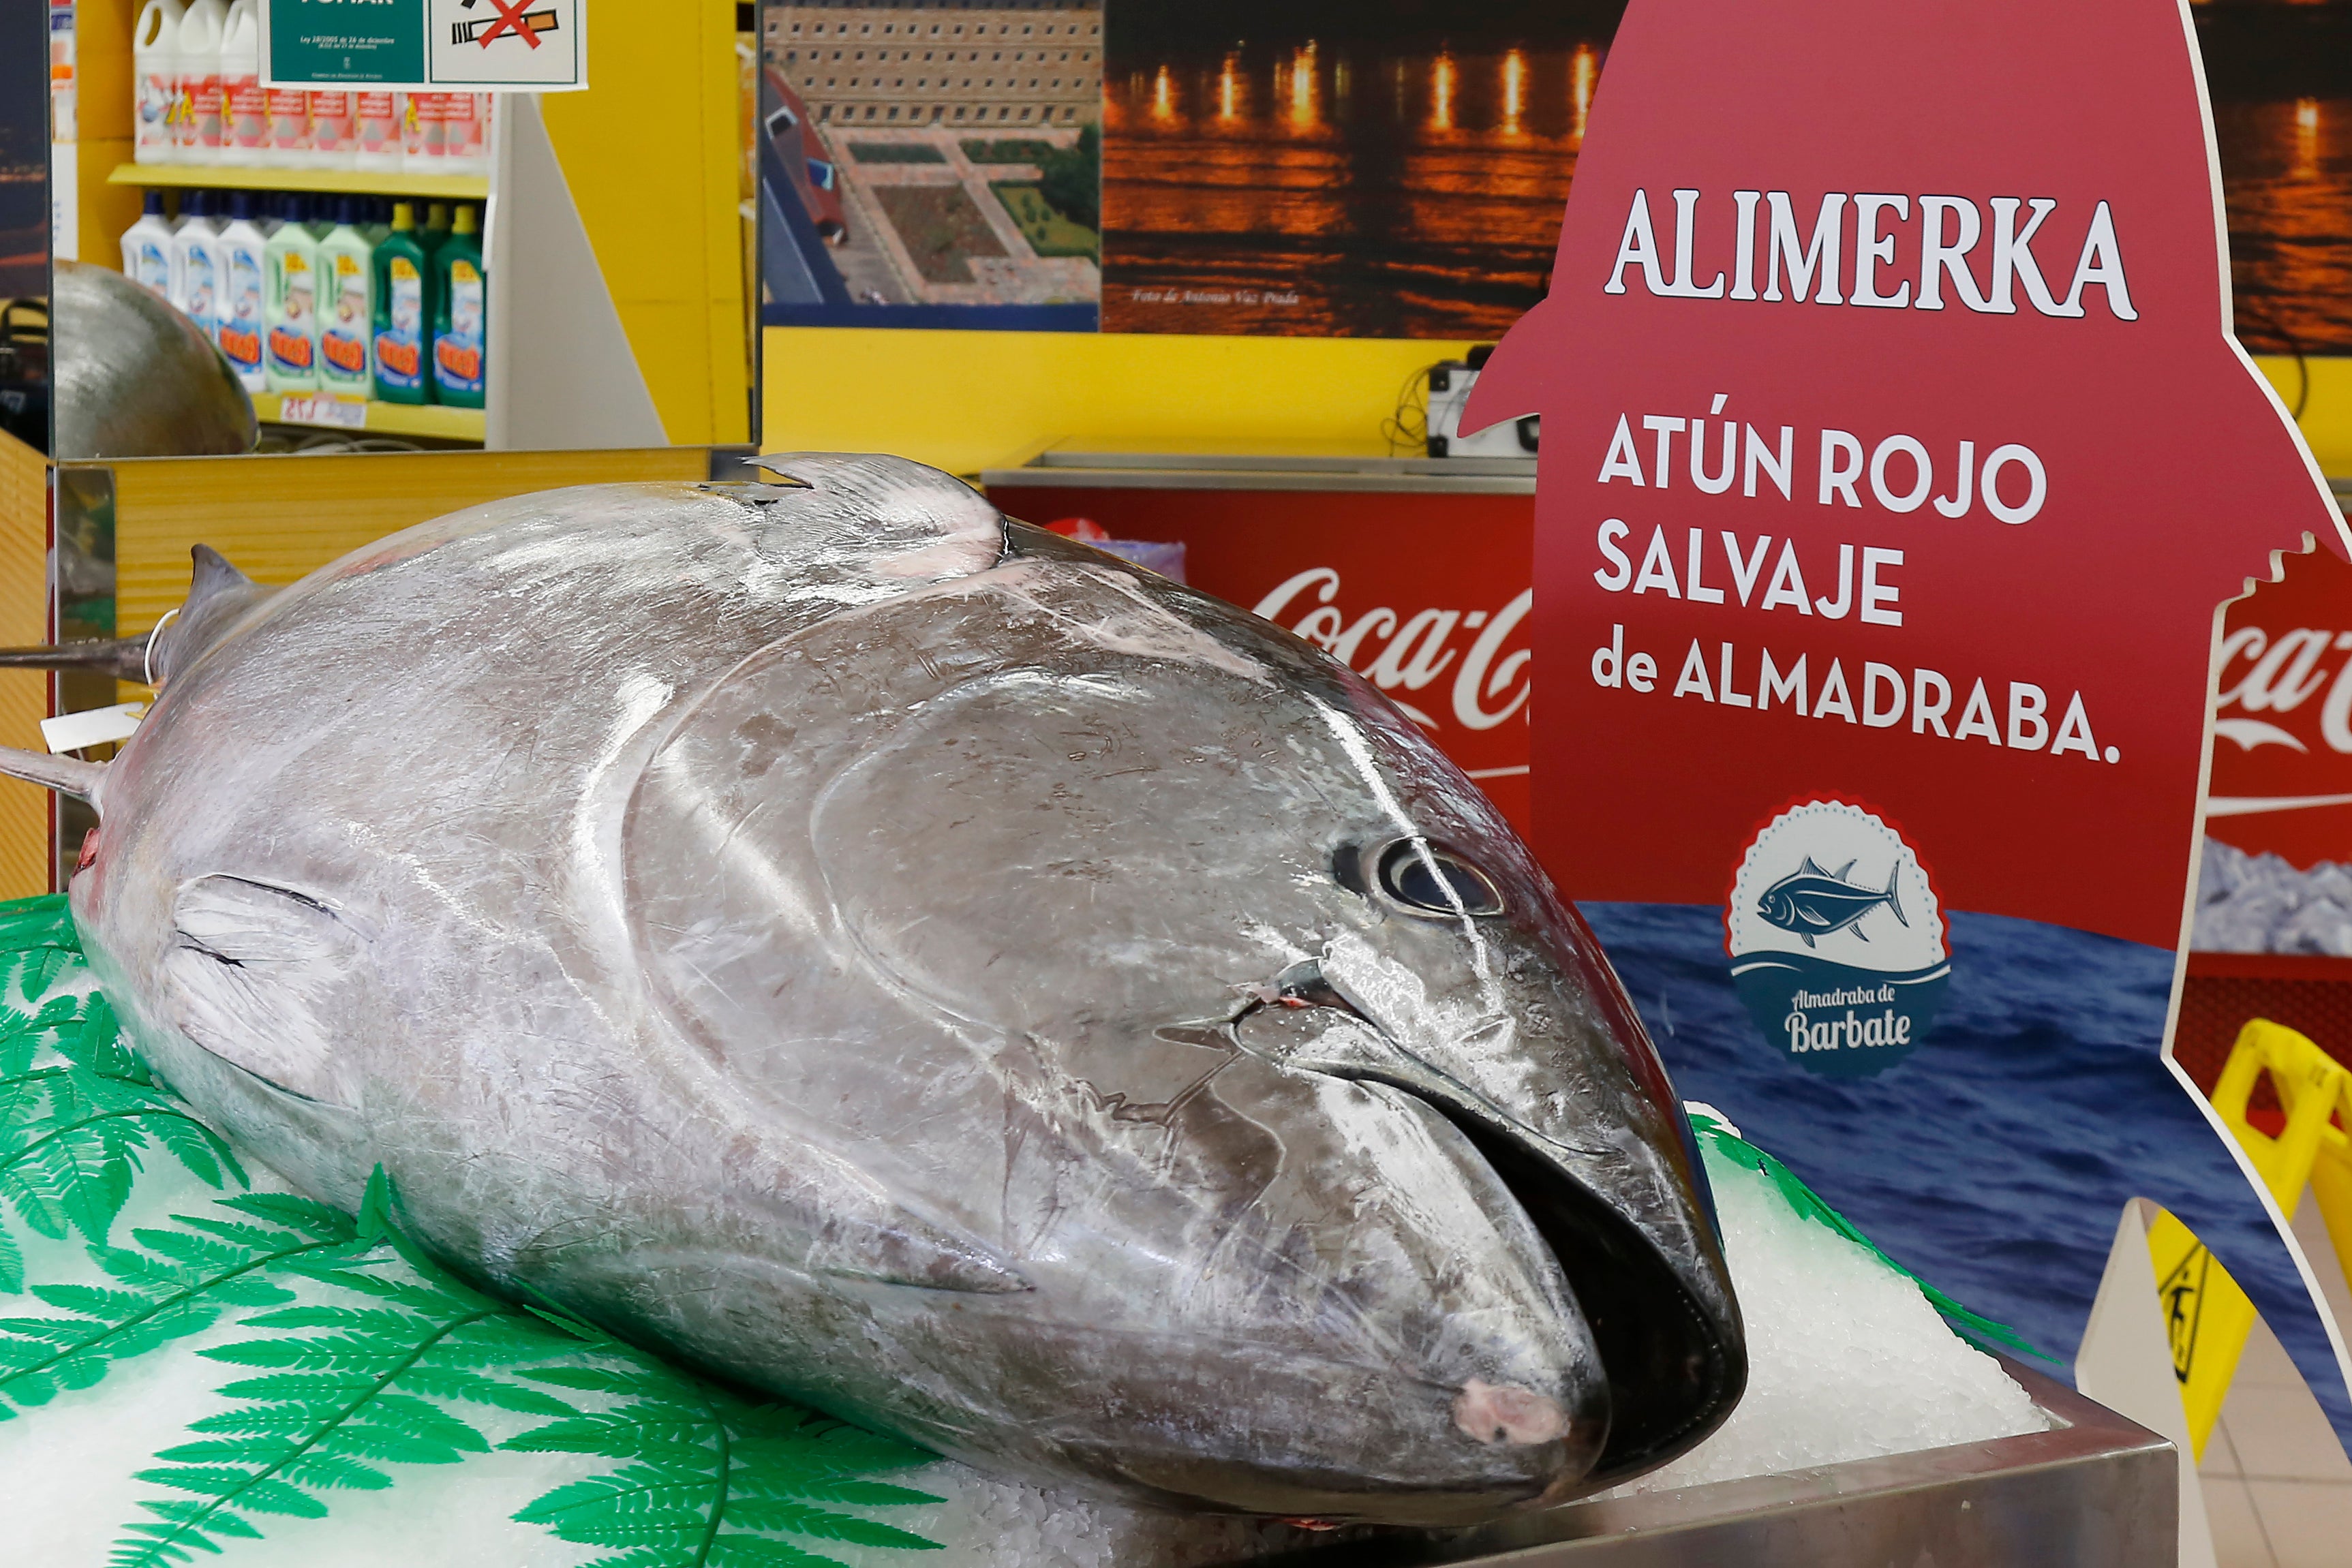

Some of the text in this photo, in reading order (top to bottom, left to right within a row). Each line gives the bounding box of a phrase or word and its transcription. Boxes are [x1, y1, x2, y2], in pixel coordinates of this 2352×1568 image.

[1604, 187, 2139, 322] ALIMERKA
[1598, 393, 2047, 525] ATÚN ROJO
[1593, 518, 1904, 627] SALVAJE
[1591, 624, 2121, 765] de ALMADRABA.
[1784, 1009, 1911, 1053] Barbate
[1791, 983, 1896, 1011] Almadraba de
